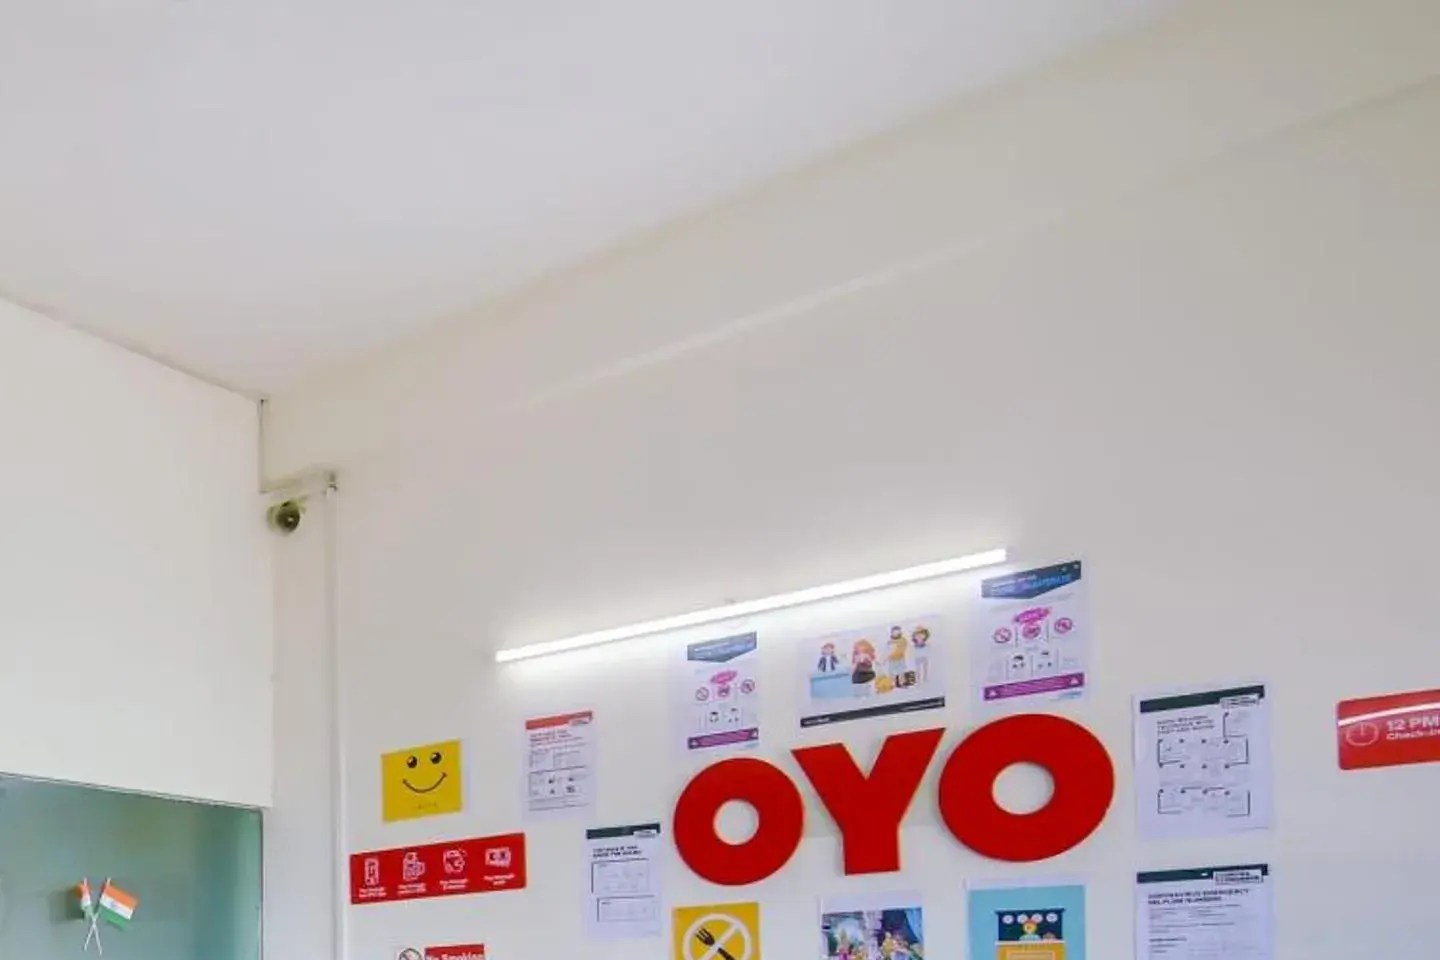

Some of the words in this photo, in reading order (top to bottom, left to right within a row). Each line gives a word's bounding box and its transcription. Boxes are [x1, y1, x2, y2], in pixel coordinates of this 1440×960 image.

[1386, 718, 1405, 731] 12
[1409, 714, 1439, 728] PM
[673, 713, 1115, 886] OYO
